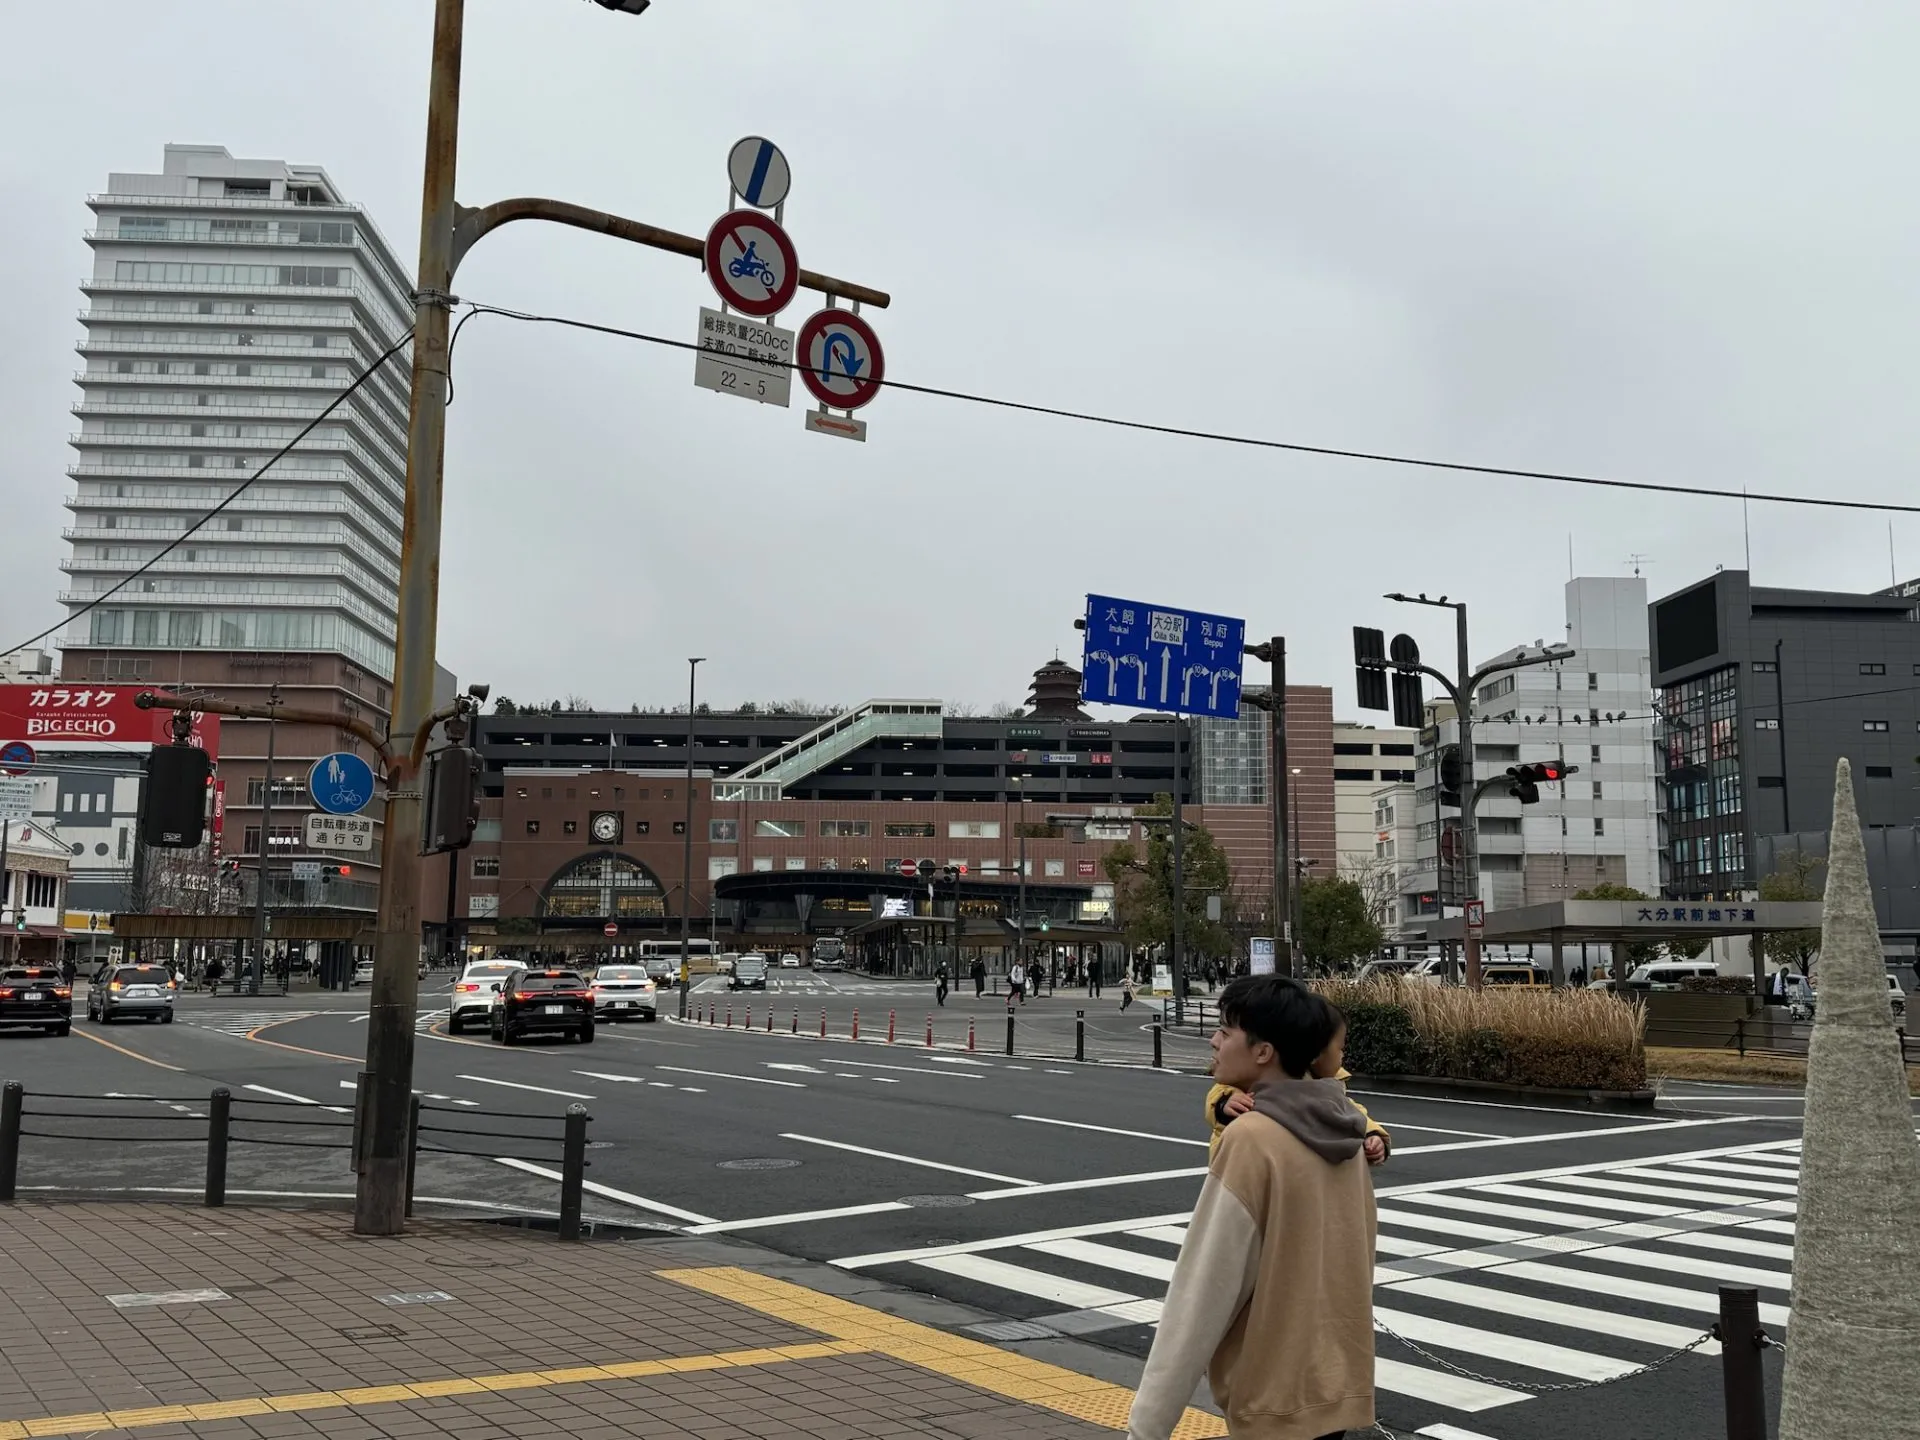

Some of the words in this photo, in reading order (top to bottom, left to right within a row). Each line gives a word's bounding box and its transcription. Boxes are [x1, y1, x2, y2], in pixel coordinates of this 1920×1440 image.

[704, 315, 789, 352] 総排気量250cc
[721, 370, 736, 389] 22
[757, 380, 766, 396] 5
[1105, 608, 1135, 625] 犬飼
[1153, 615, 1182, 633] 大分駅
[1154, 630, 1168, 641] Oita
[1200, 621, 1228, 639] 別府
[1203, 637, 1224, 649] Beppu
[29, 690, 116, 707] カラオケ
[27, 718, 62, 735] BIG
[65, 719, 116, 735] ECHO
[311, 818, 371, 832] 自転車歩道
[316, 832, 364, 846] 通行可
[1638, 907, 1756, 923] 大分駅前地下道
